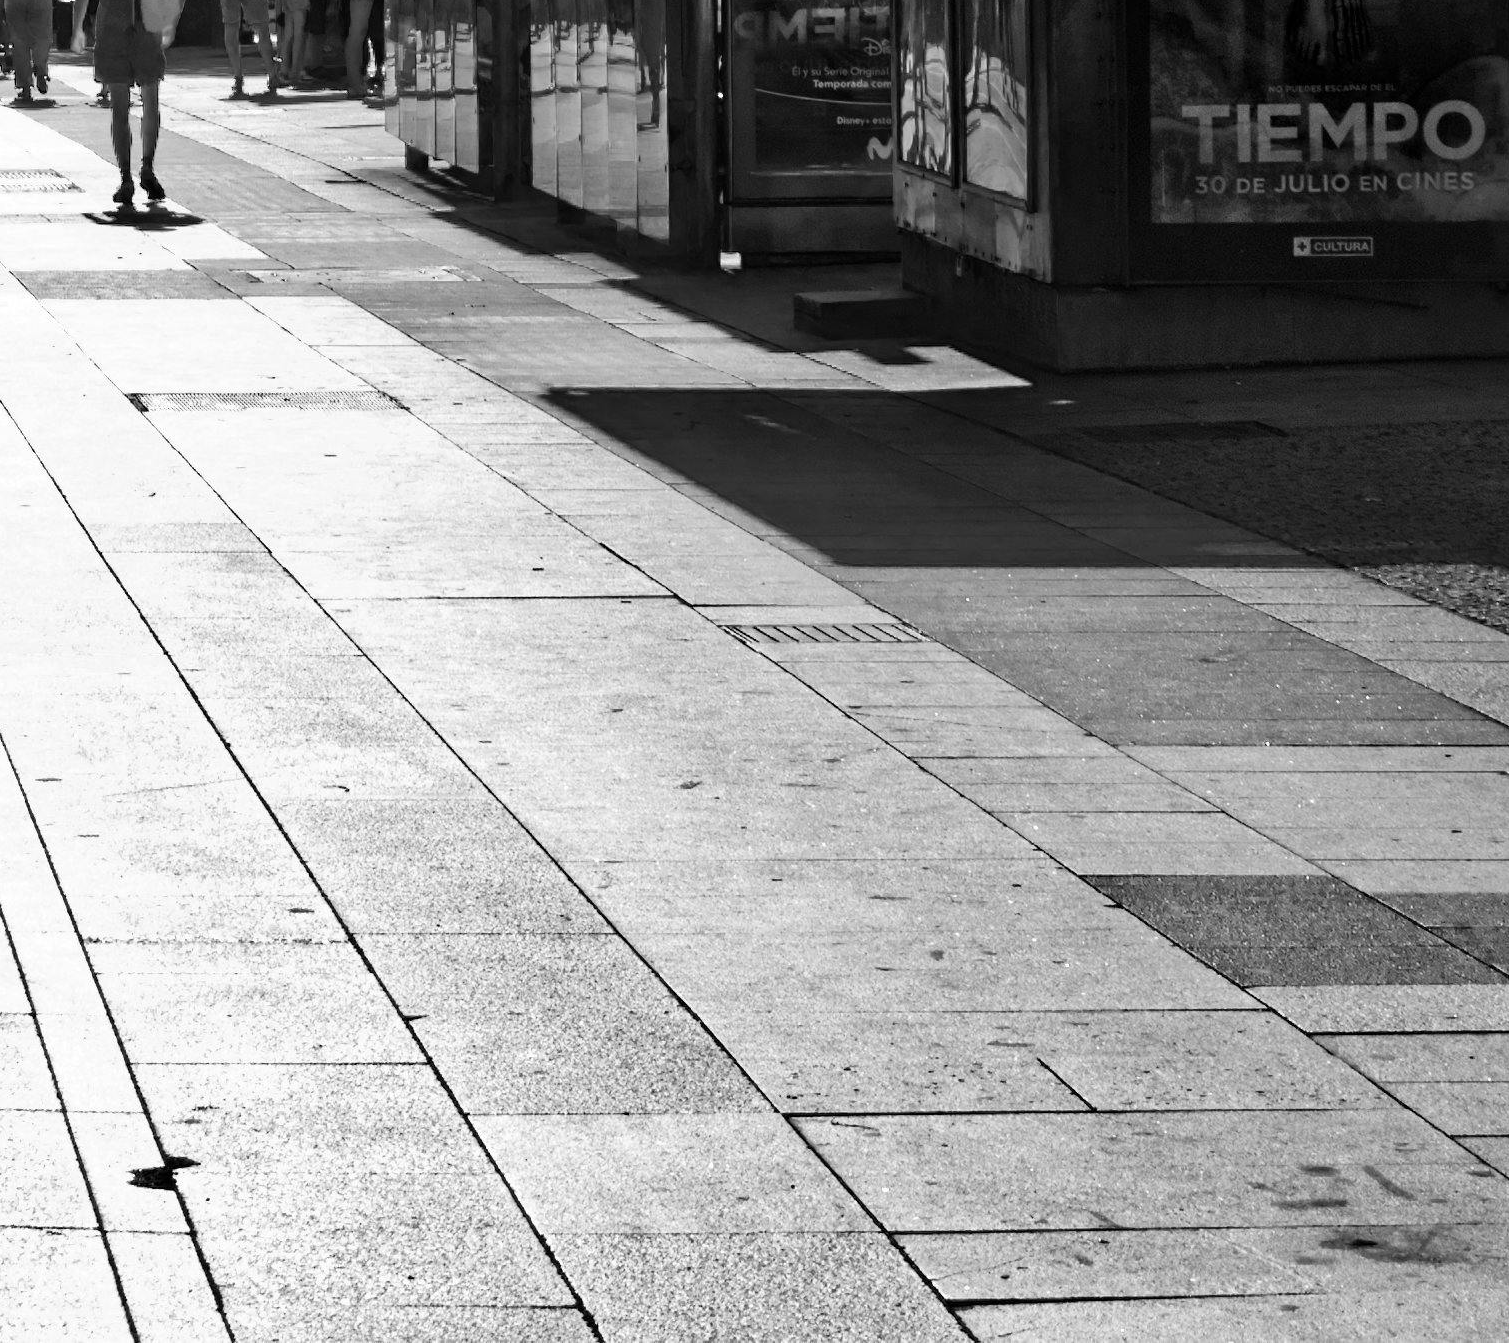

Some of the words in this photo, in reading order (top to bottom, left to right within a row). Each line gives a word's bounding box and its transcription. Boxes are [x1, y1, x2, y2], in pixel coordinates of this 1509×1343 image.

[850, 66, 890, 78] Original
[812, 79, 869, 91] Temporada
[1286, 84, 1322, 93] PUEDES
[1182, 99, 1486, 164] TIEMPO
[1195, 175, 1227, 194] 30
[1236, 177, 1266, 194] DE
[1274, 174, 1351, 194] JULIO
[1359, 176, 1388, 192] EN
[1396, 171, 1475, 192] CINES
[1313, 241, 1370, 253] CULTURA
